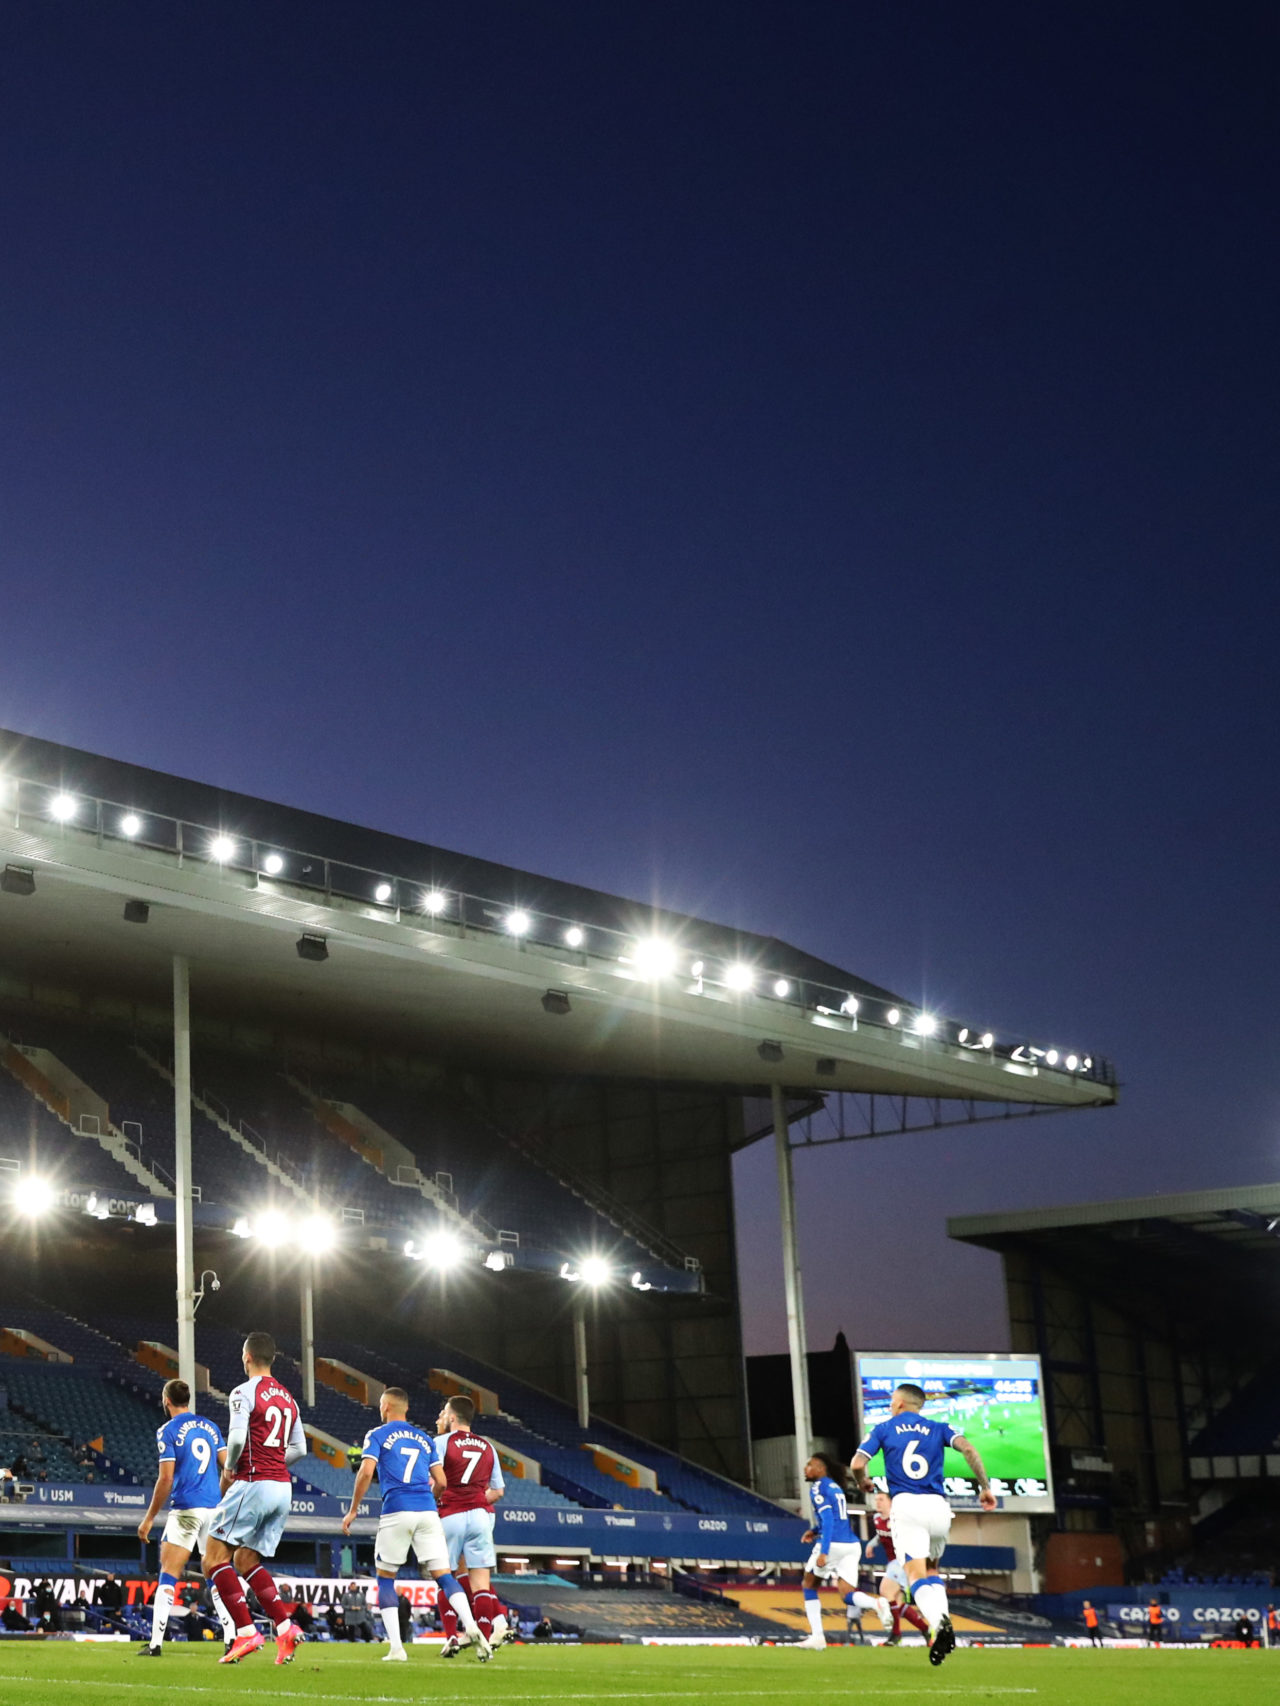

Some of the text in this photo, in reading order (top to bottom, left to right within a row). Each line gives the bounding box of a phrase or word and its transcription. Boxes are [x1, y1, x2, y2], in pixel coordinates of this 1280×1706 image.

[175, 1420, 219, 1447] CALVERT-LEWIN
[263, 1405, 292, 1448] 21
[895, 1423, 931, 1436] ALLAN
[383, 1430, 432, 1455] RICHARLISON
[454, 1437, 488, 1451] McGINN
[191, 1437, 211, 1475] 9
[902, 1440, 929, 1480] 6
[400, 1447, 420, 1484] 7
[461, 1450, 482, 1484] 7
[50, 1489, 74, 1502] USM
[289, 1500, 315, 1513] ZOO
[503, 1510, 536, 1522] CAZOO
[566, 1512, 584, 1525] USM
[698, 1519, 728, 1532] CAZOO
[14, 1578, 200, 1606] DVAN TYE
[293, 1585, 436, 1606] AVAN RES
[1120, 1607, 1180, 1621] CAZO
[1193, 1607, 1261, 1622] CAZOO
